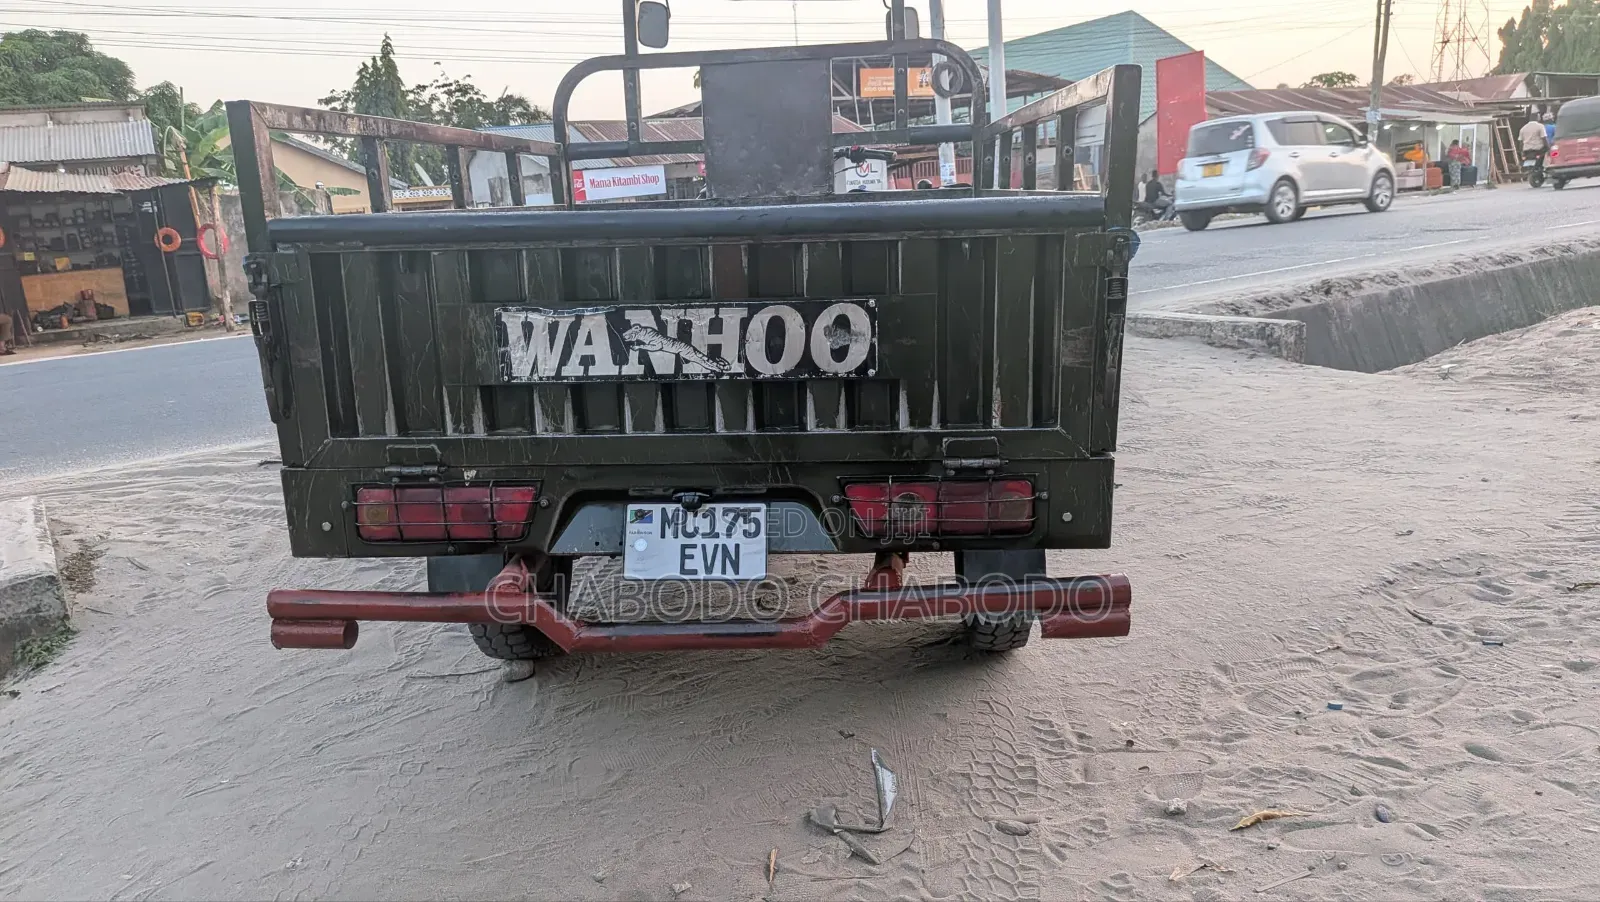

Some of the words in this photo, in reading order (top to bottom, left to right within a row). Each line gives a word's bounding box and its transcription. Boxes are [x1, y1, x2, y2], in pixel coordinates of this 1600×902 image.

[589, 178, 612, 189] Mama
[612, 174, 641, 187] Kitambi
[641, 173, 660, 185] Shop
[500, 302, 872, 376] WANHOO
[660, 506, 762, 539] MC175
[679, 543, 741, 576] EVN
